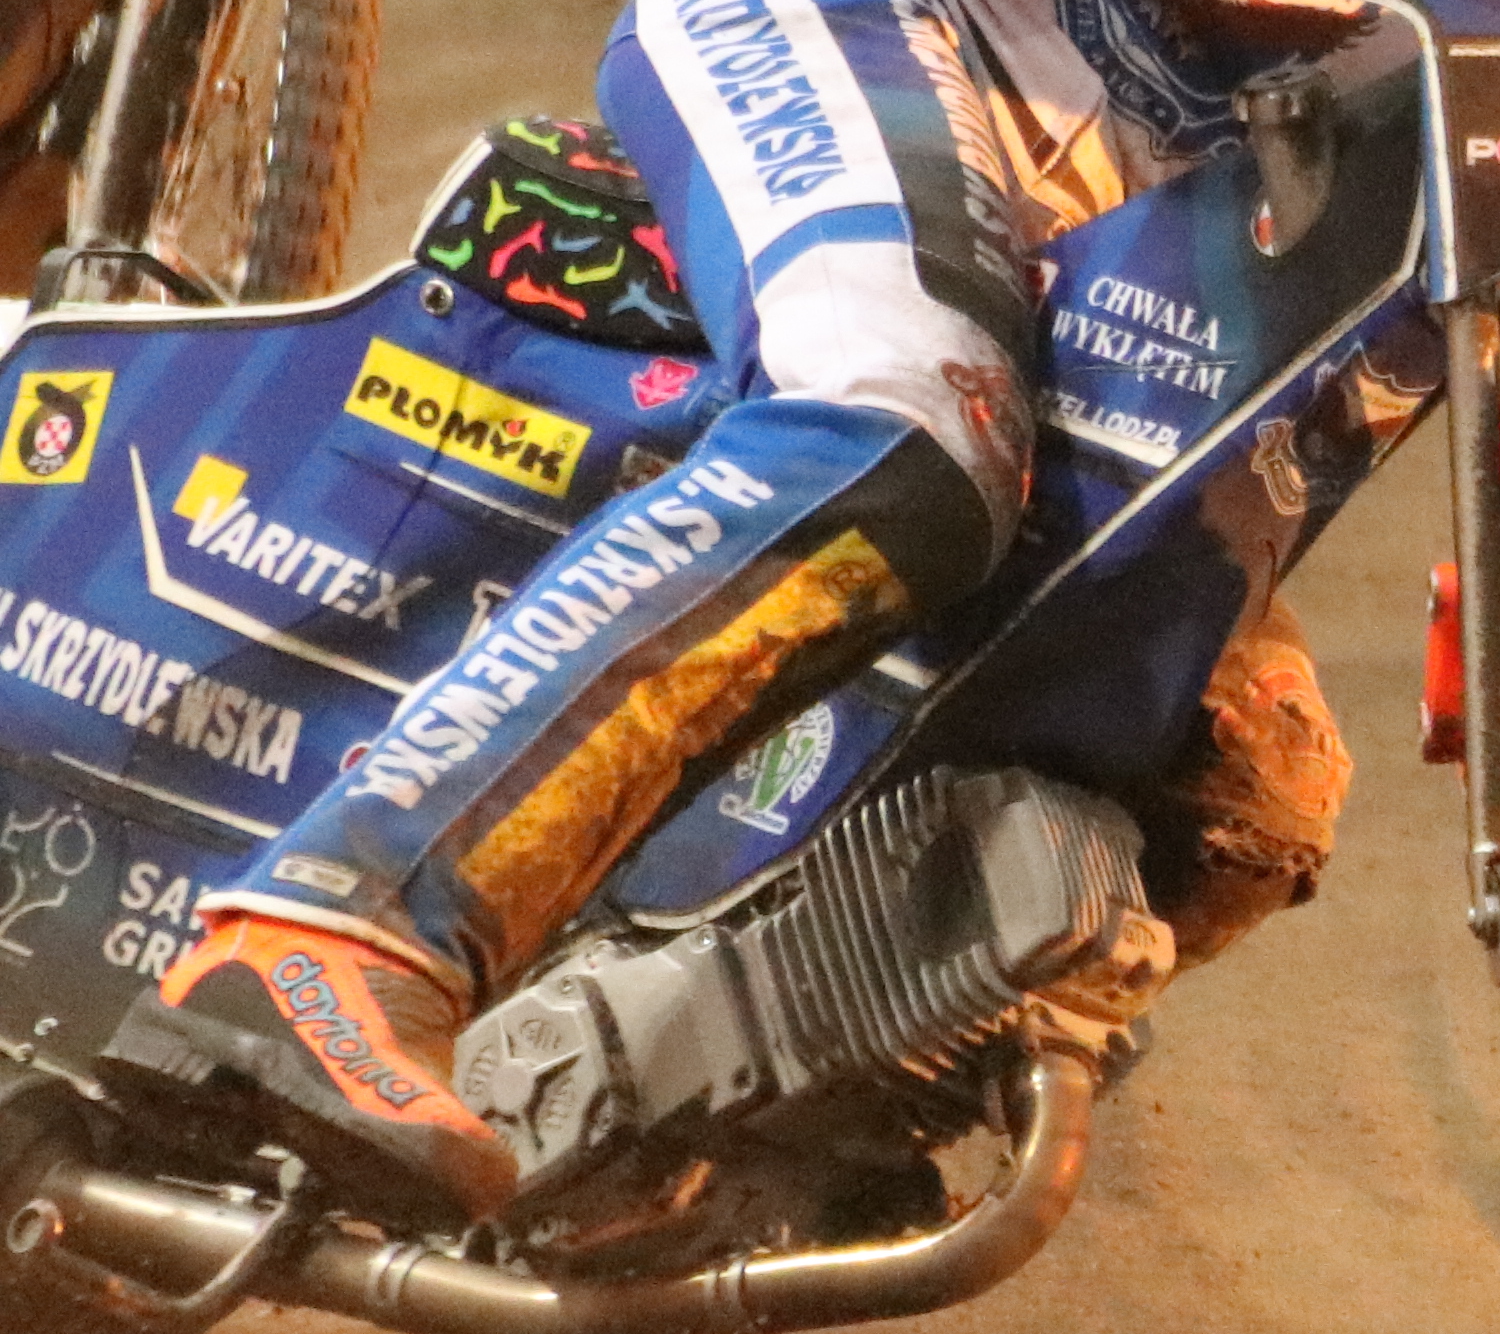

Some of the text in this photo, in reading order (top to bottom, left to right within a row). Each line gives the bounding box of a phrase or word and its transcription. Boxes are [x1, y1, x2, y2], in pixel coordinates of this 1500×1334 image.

[1087, 274, 1220, 353] CHWAŁA
[356, 373, 574, 486] PŁOMYK
[186, 495, 434, 631] VARITEX
